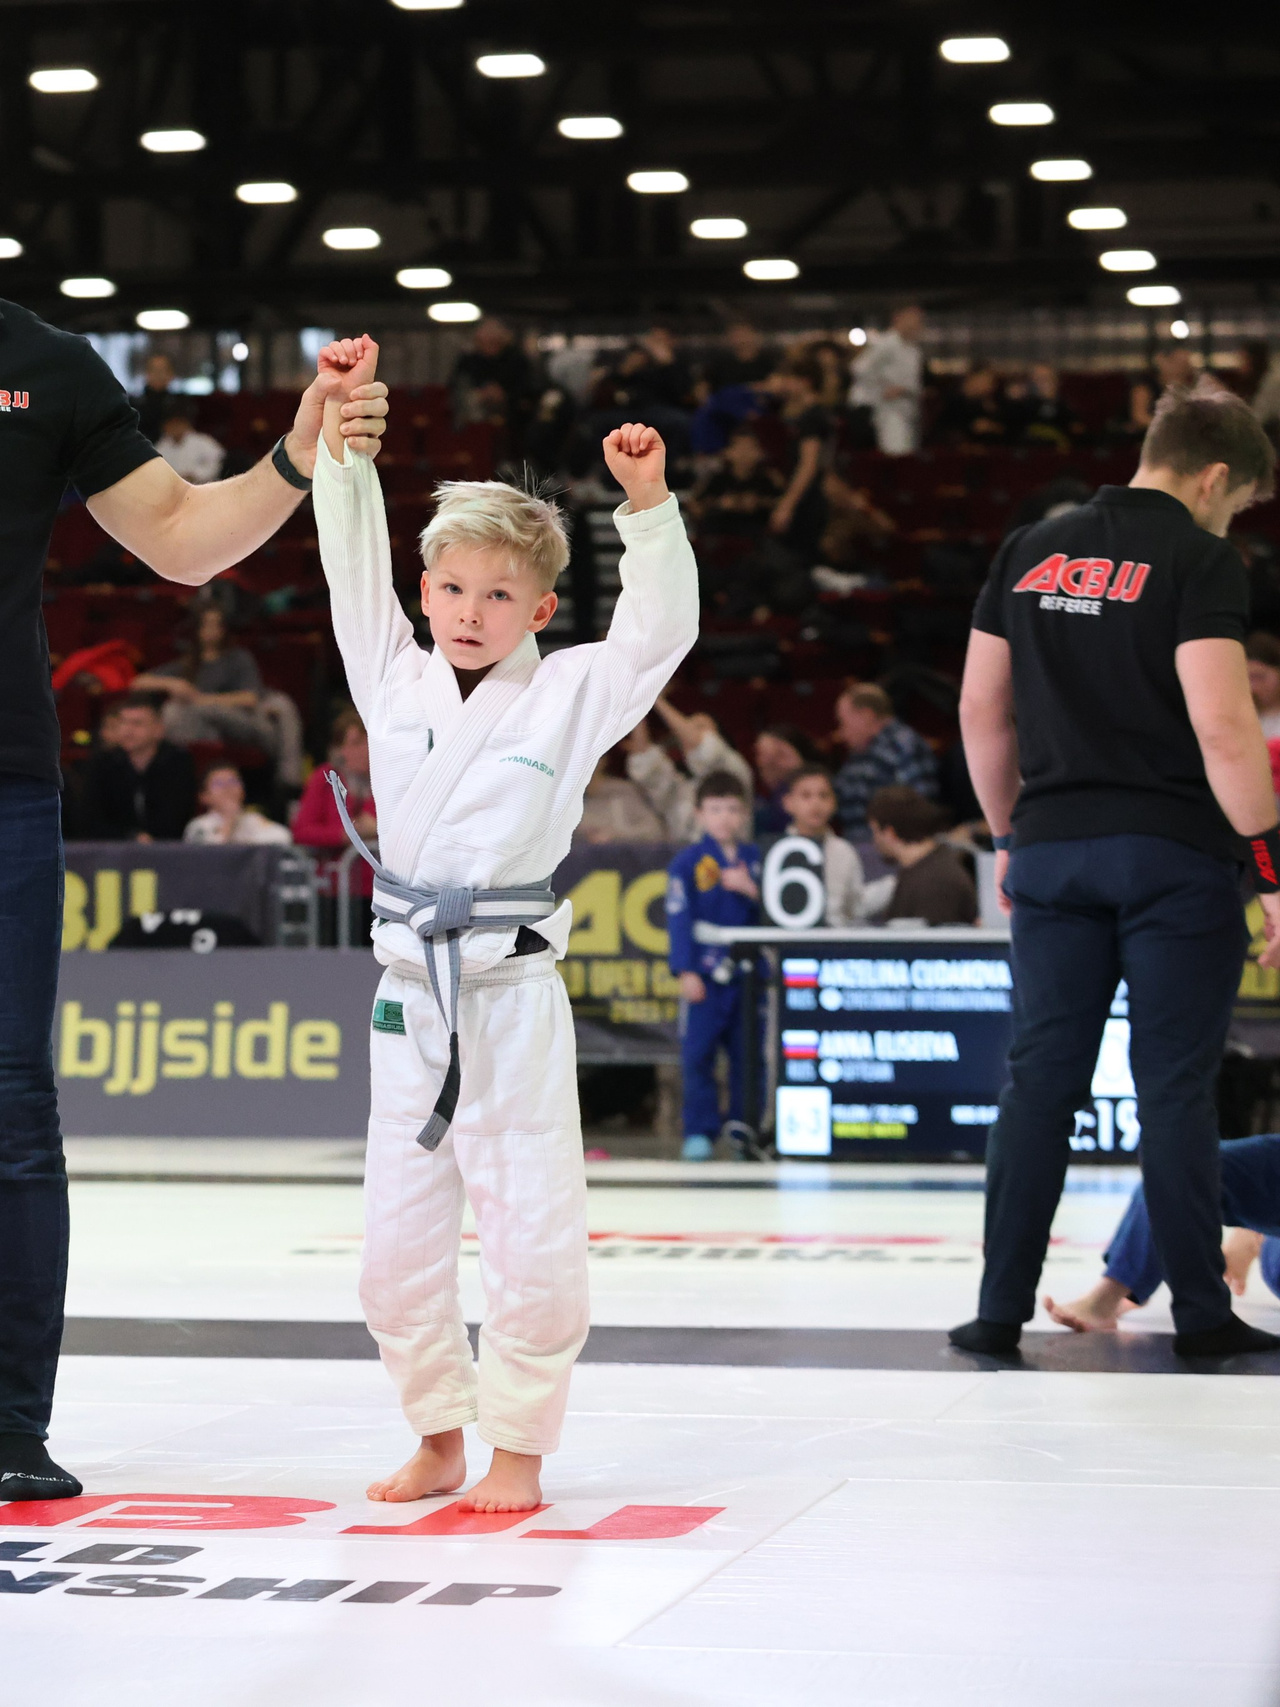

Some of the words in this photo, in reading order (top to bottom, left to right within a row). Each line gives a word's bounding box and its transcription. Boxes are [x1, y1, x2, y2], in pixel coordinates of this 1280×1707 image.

[1039, 595, 1103, 616] REFEREE
[762, 836, 823, 929] 6
[58, 1001, 342, 1097] bjjside
